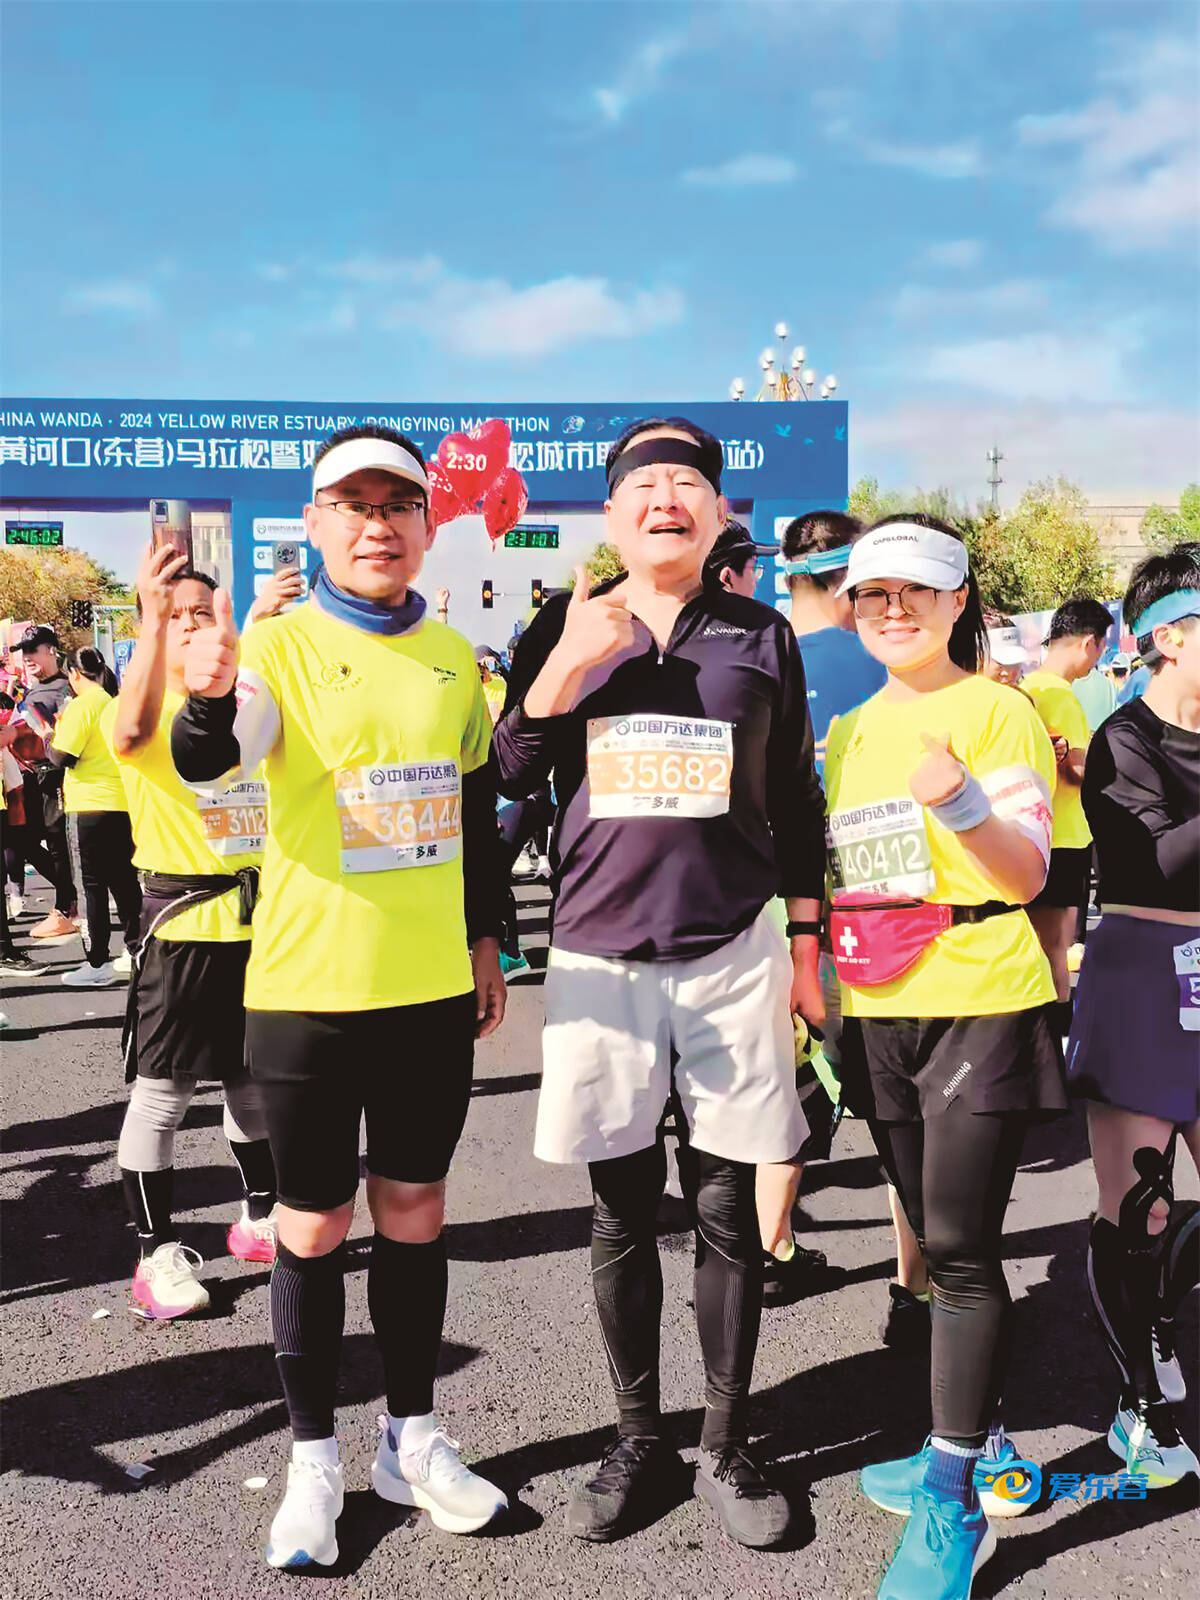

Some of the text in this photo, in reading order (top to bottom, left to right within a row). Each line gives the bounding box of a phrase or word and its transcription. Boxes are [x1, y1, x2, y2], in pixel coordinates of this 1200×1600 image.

[40, 412, 103, 428] WANDA
[119, 413, 153, 428] 2024
[158, 413, 226, 429] YELLOW
[231, 414, 279, 430] RIVER
[284, 415, 356, 432] ESTUARY
[460, 416, 550, 433] MATHON
[446, 451, 487, 472] 2:30
[7, 528, 60, 545] 2:46:02
[632, 720, 723, 738] 中国万达集团
[615, 754, 728, 793] 35682
[374, 799, 460, 843] 36444
[839, 800, 913, 827] 中国万达集团
[842, 833, 926, 881] 40412
[942, 1060, 972, 1098] RUNNING
